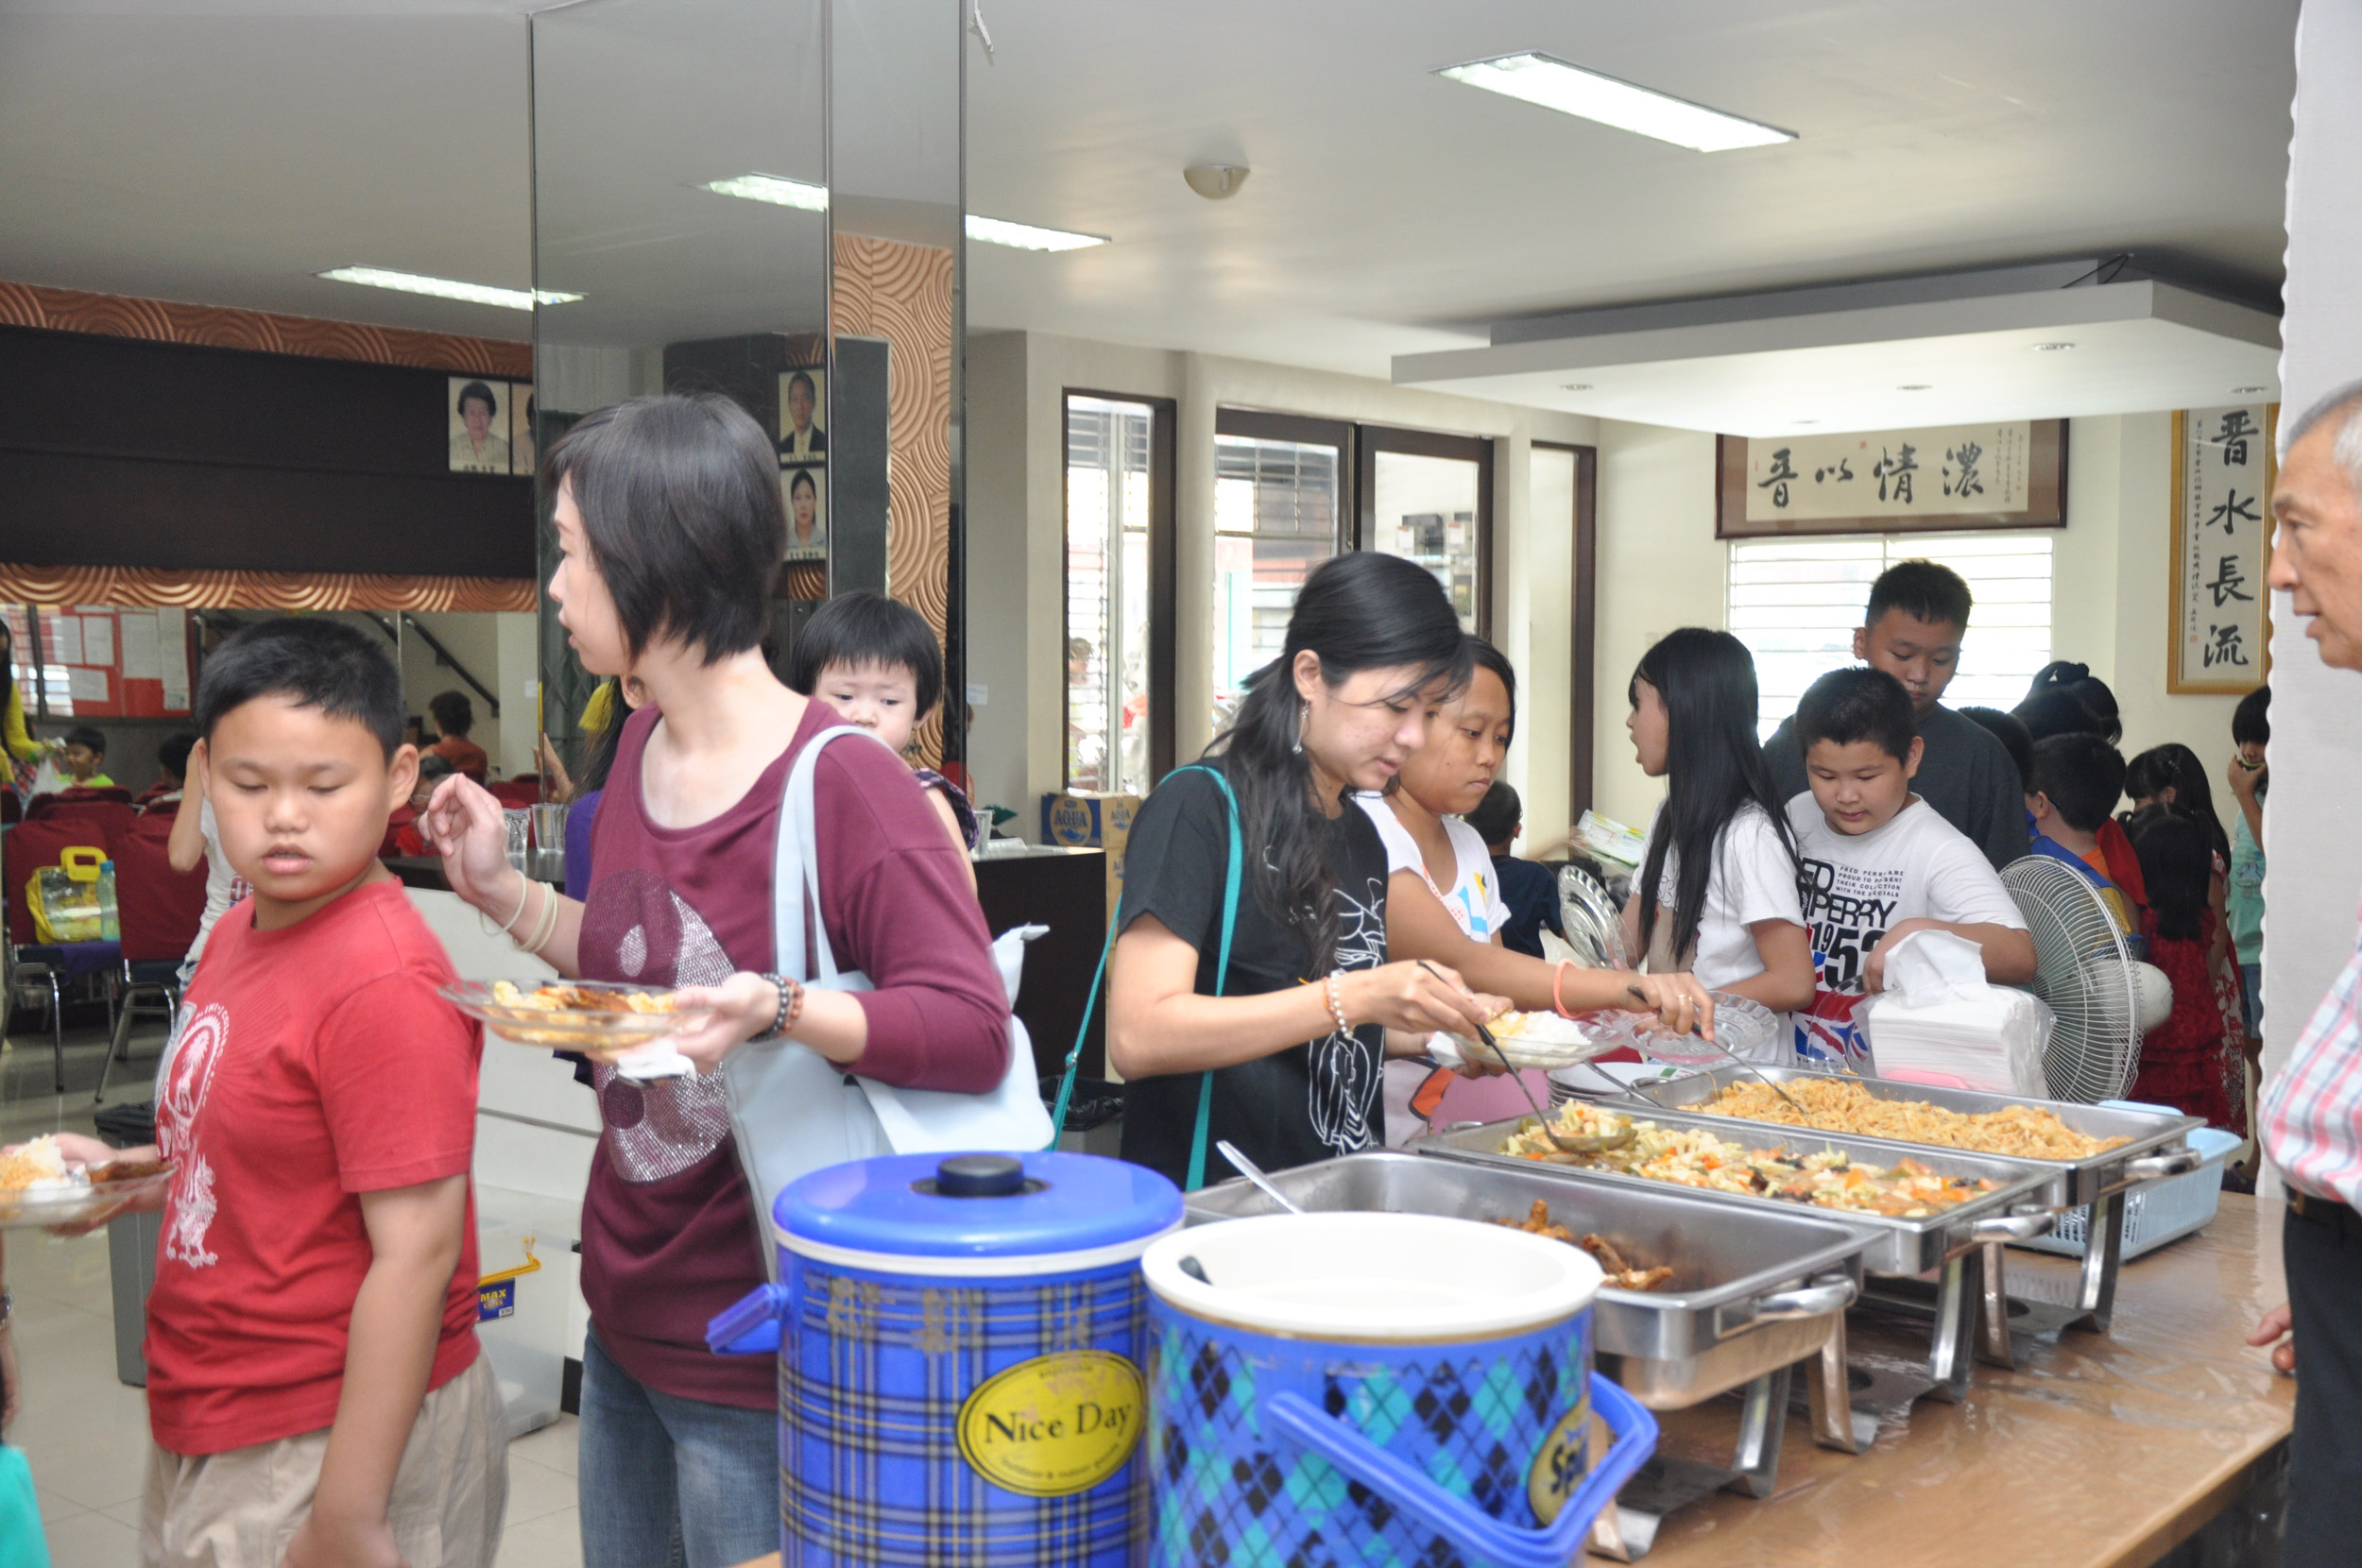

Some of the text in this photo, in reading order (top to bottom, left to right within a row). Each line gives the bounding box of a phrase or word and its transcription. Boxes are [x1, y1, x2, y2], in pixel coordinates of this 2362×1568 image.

[1054, 809, 1088, 829] AQUA
[1808, 891, 1898, 929] PERRY
[480, 1288, 506, 1303] MAX
[984, 1402, 1132, 1444] Nice Day
